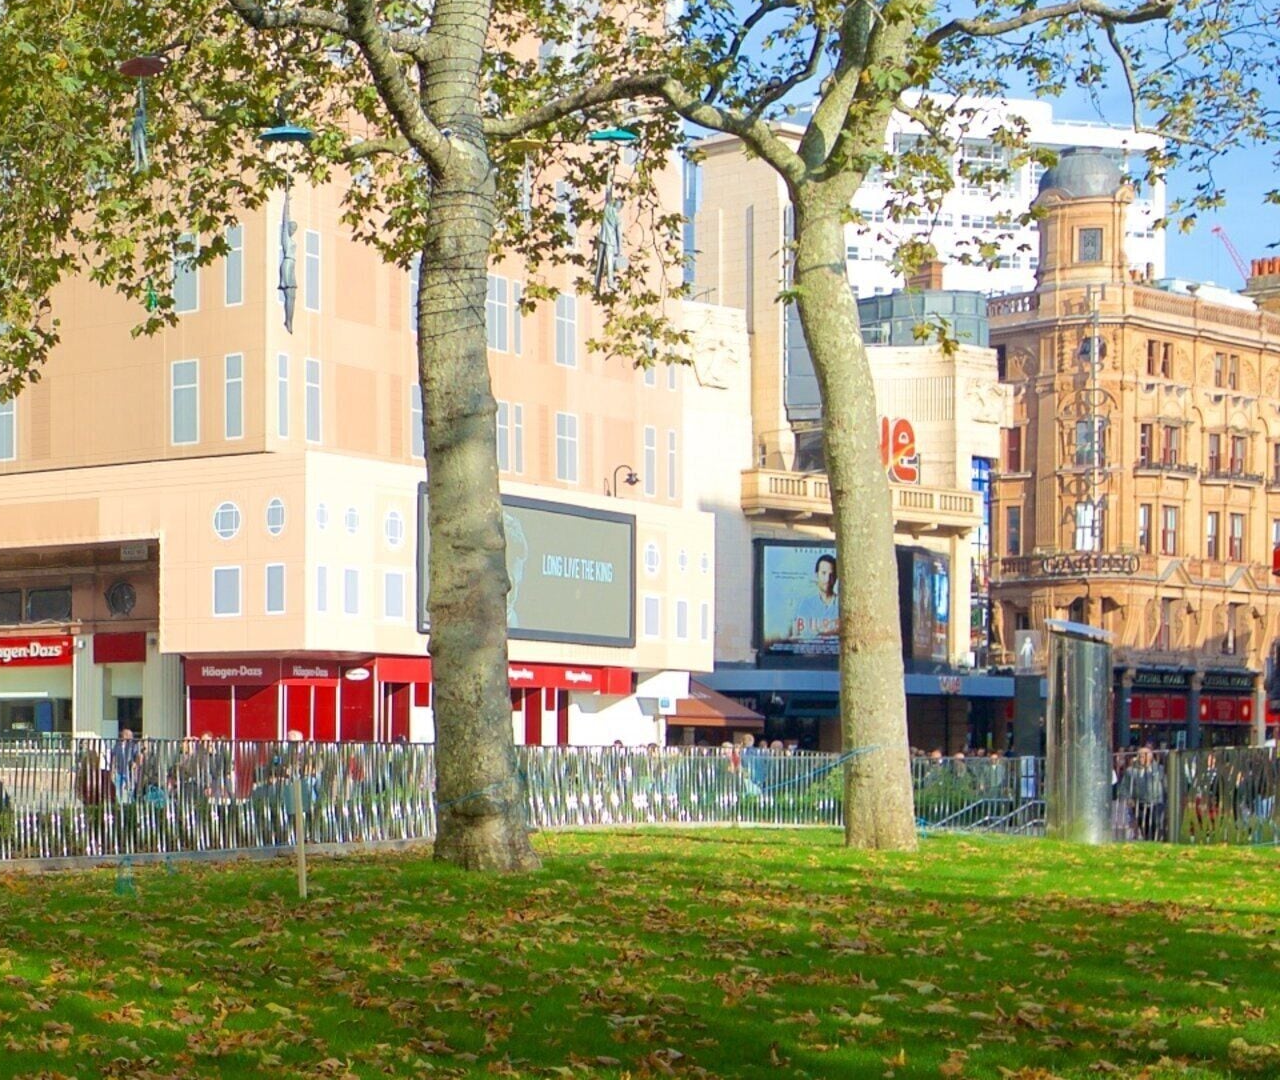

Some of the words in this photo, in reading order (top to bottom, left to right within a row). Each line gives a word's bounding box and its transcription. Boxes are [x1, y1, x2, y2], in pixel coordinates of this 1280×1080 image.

[542, 554, 562, 577] LONG
[564, 556, 580, 579] LIVE
[580, 558, 595, 581] THE
[595, 561, 613, 583] KING
[201, 665, 262, 679] Häagen-Dazs
